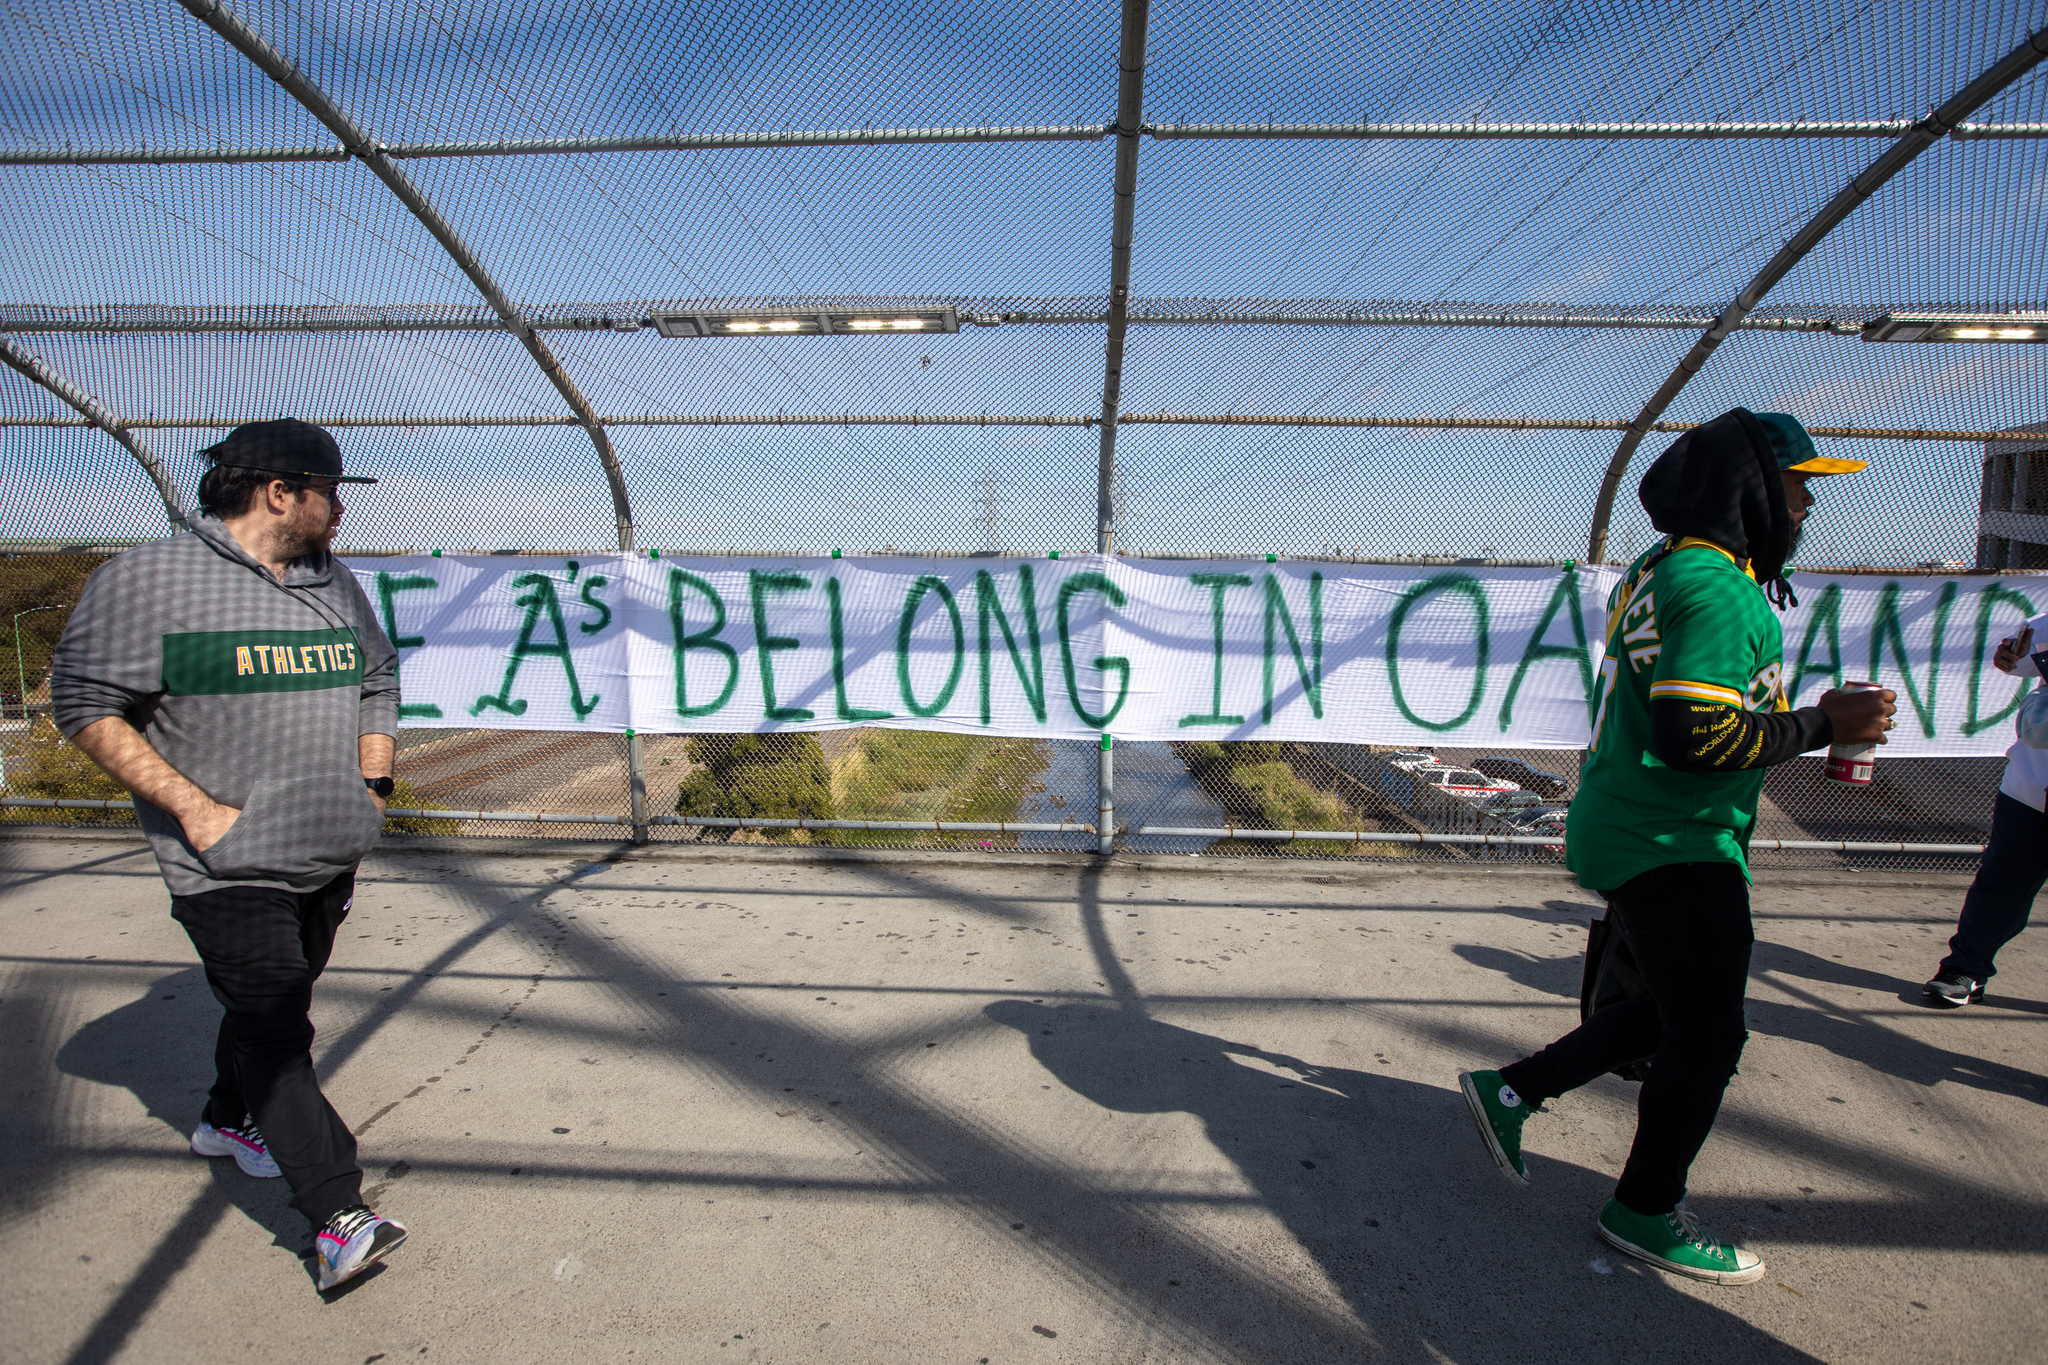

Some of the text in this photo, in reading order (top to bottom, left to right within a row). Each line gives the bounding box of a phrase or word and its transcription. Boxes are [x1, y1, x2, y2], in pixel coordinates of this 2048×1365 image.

[236, 643, 355, 675] ATHLETICS
[377, 560, 2038, 738] E A's BELONG IN OAAND
